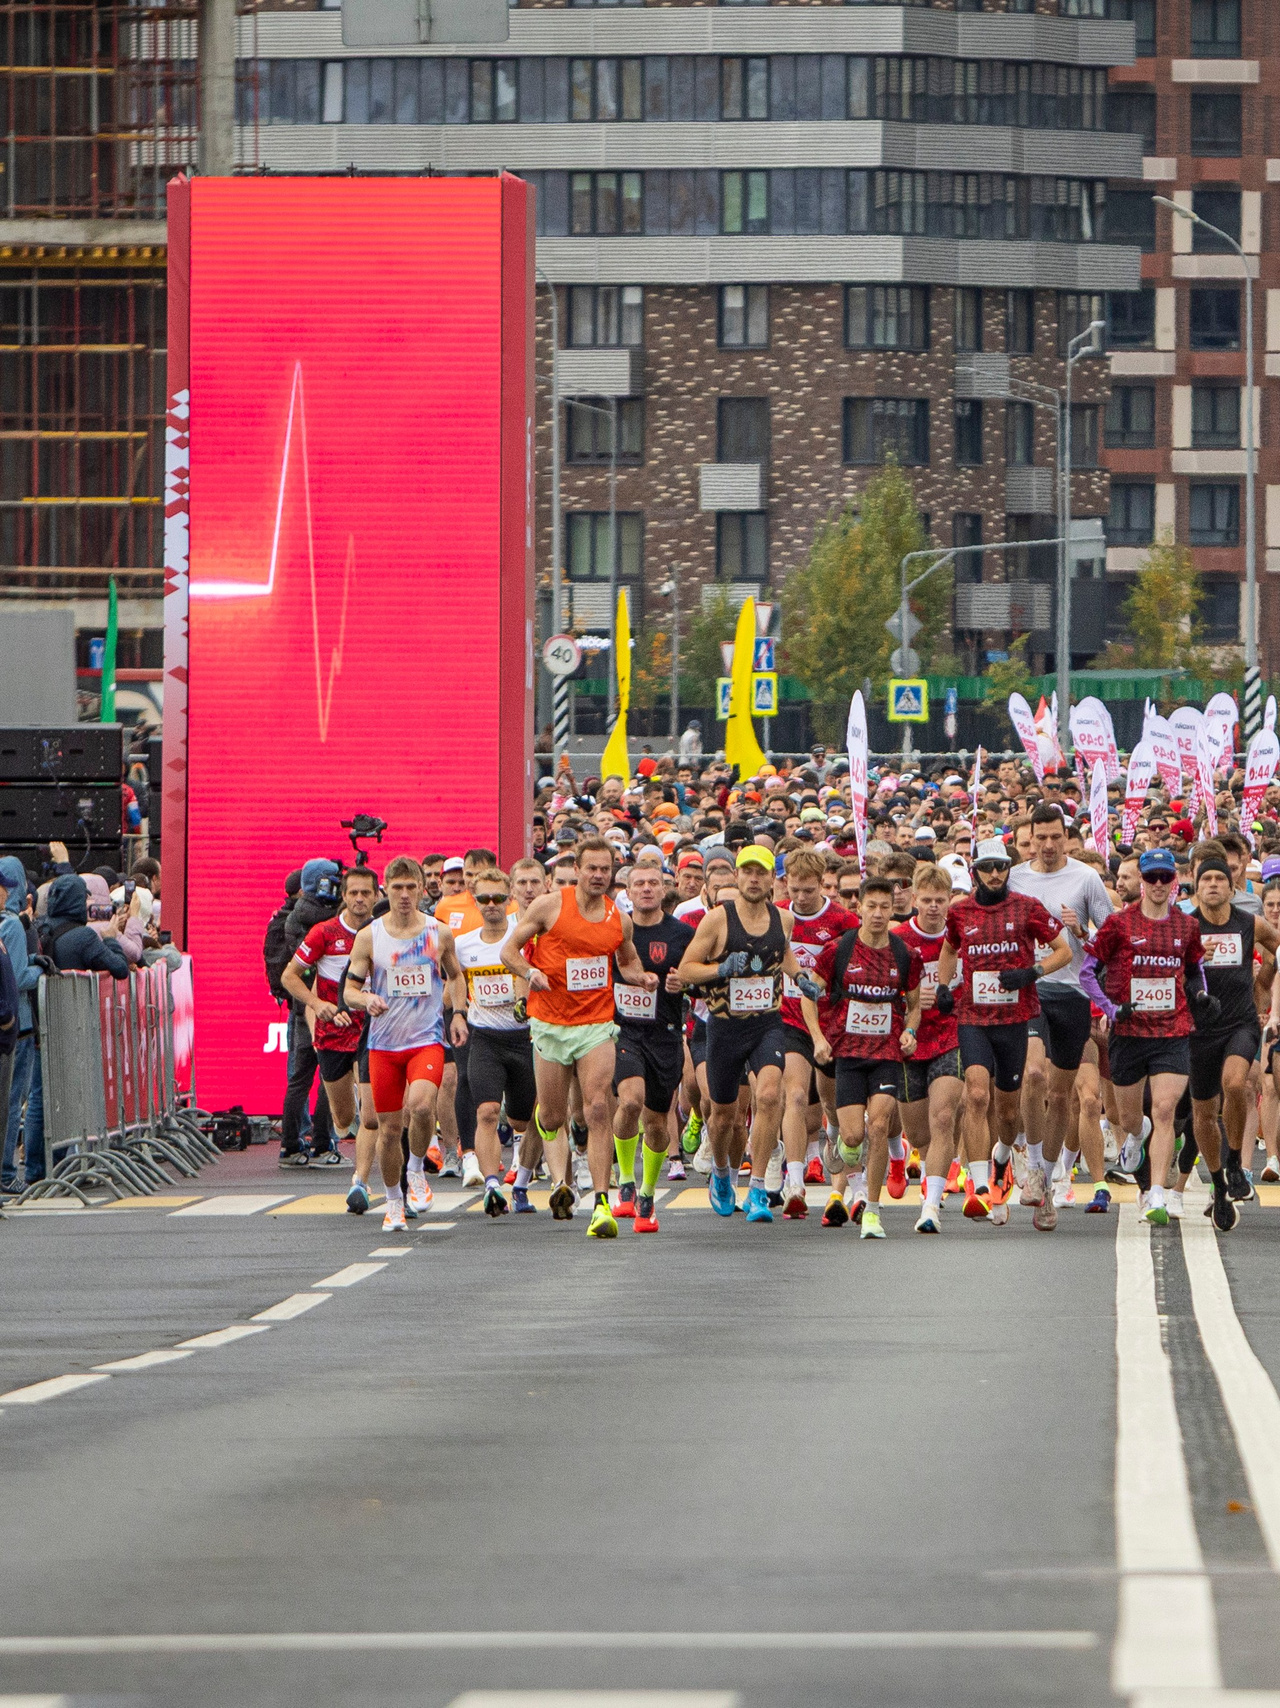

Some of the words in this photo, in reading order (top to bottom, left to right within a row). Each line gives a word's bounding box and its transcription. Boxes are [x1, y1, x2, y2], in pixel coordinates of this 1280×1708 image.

[551, 646, 572, 663] 40
[1249, 764, 1270, 781] 0:44
[968, 941, 1019, 955] ЛУКОЙЛ
[1132, 953, 1181, 967] ЛУКОЙЛ
[394, 973, 425, 987] 1613
[571, 966, 606, 982] 2868
[478, 983, 509, 996] 1036
[735, 987, 771, 1001] 2436
[848, 983, 898, 997] ЛУКОЙЛ
[978, 982, 1013, 995] 248
[1135, 988, 1173, 1001] 2405
[618, 992, 652, 1008] 1280
[852, 1012, 888, 1027] 2457
